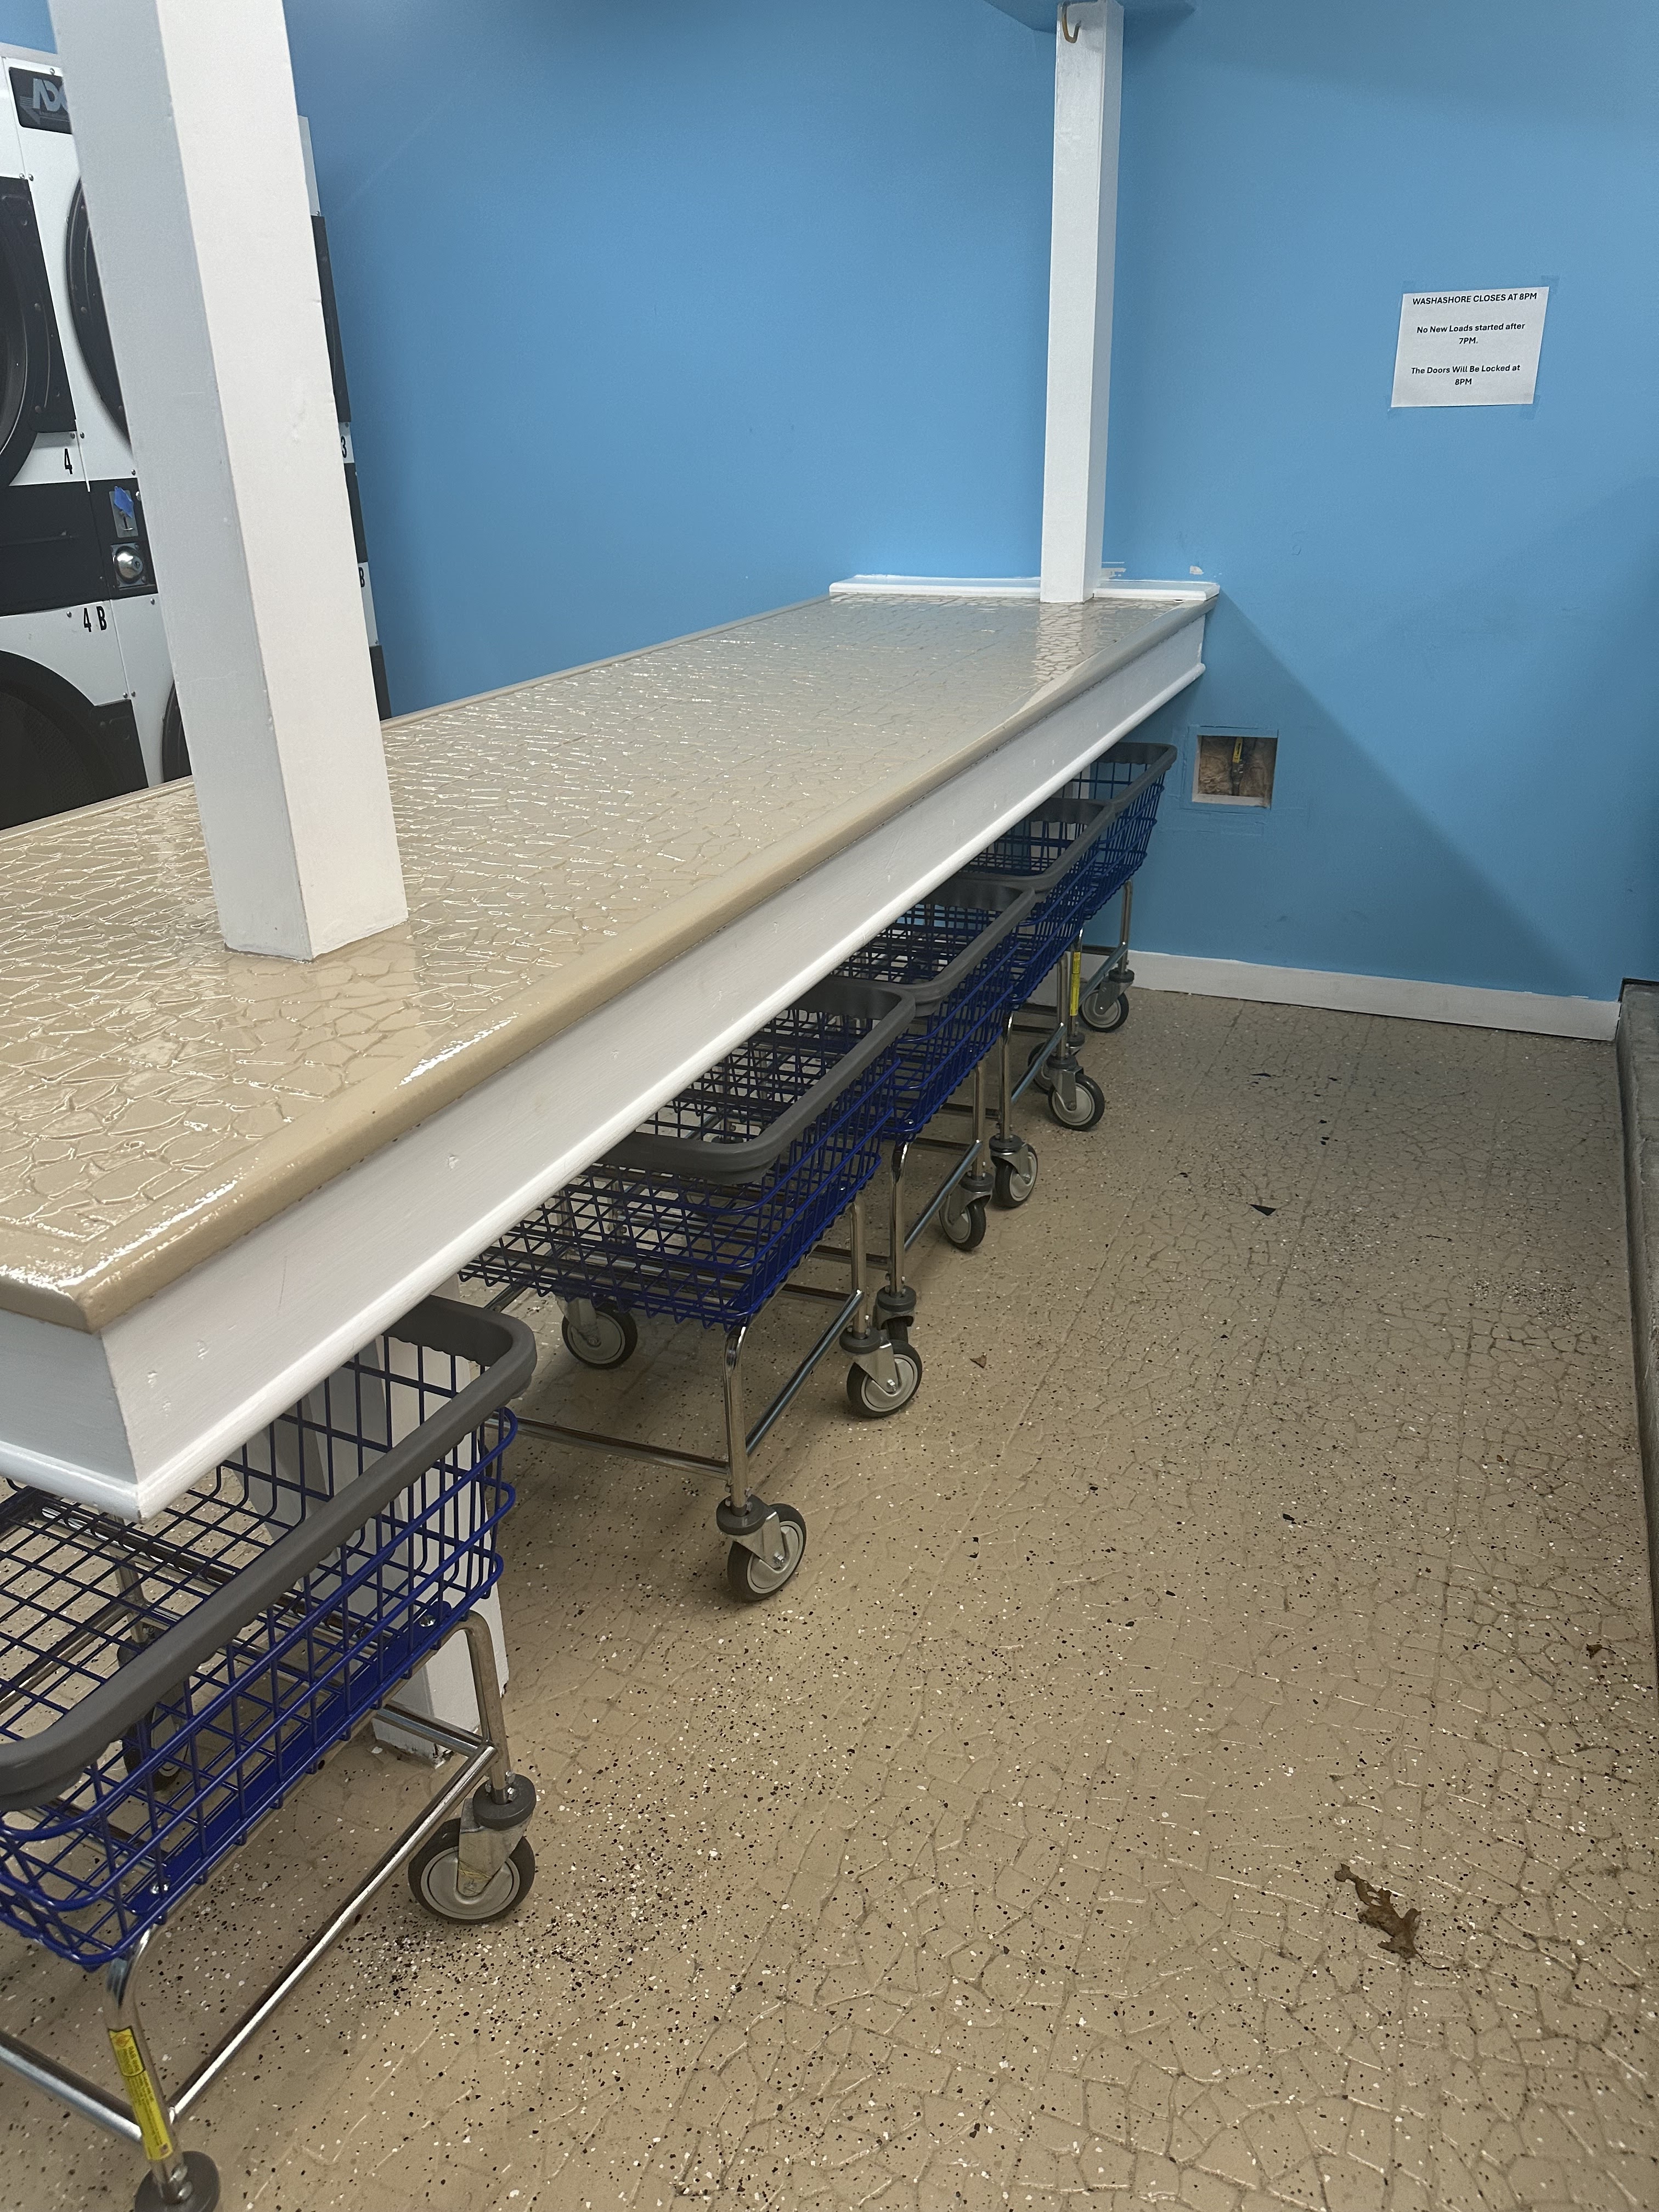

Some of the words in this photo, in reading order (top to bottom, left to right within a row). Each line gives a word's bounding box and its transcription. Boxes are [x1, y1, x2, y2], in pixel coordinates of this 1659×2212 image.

[1413, 296, 1471, 305] WASHASHORE
[1473, 294, 1506, 302] CLOSES
[1475, 323, 1504, 331] started
[341, 435, 347, 459] 3
[64, 448, 73, 475] 4
[83, 607, 92, 633] 4
[96, 606, 108, 631] B
